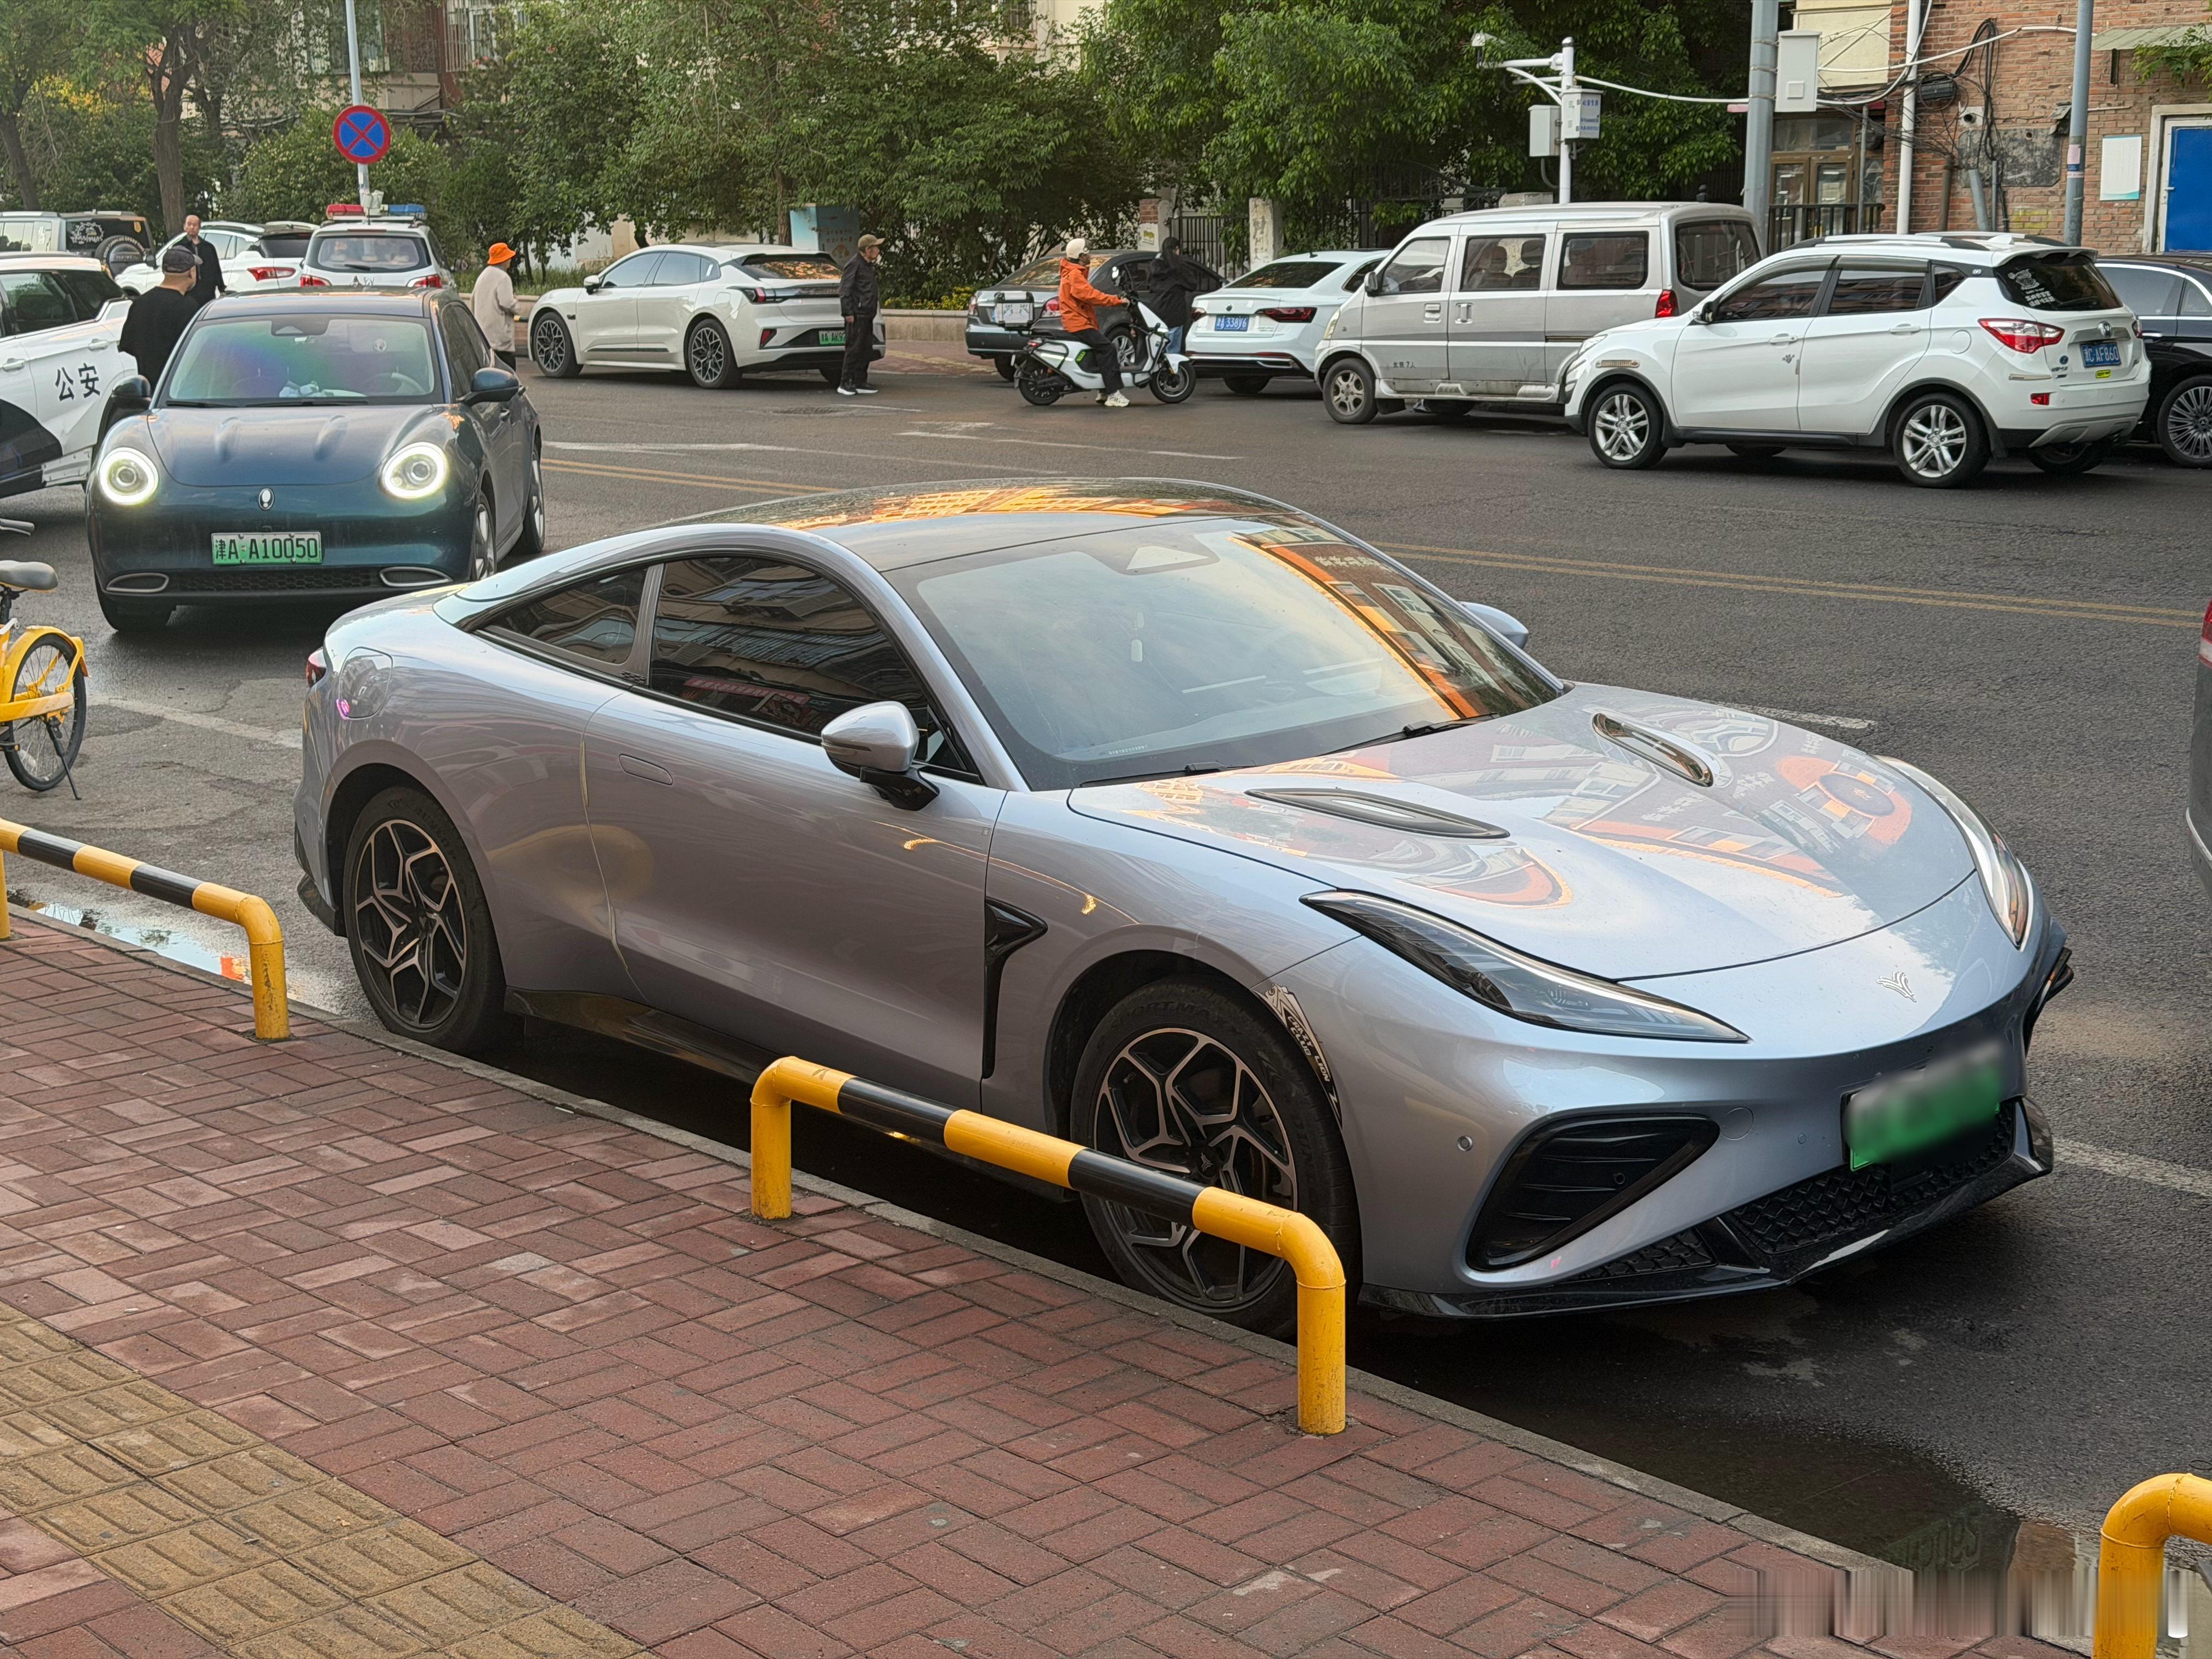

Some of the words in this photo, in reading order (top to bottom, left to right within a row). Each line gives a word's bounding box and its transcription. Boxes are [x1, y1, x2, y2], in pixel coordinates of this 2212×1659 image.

[55, 362, 100, 402] 公安
[1287, 1015, 1314, 1047] CRAZY
[1290, 1026, 1312, 1056] CLUB
[1314, 1055, 1330, 1082] LION
